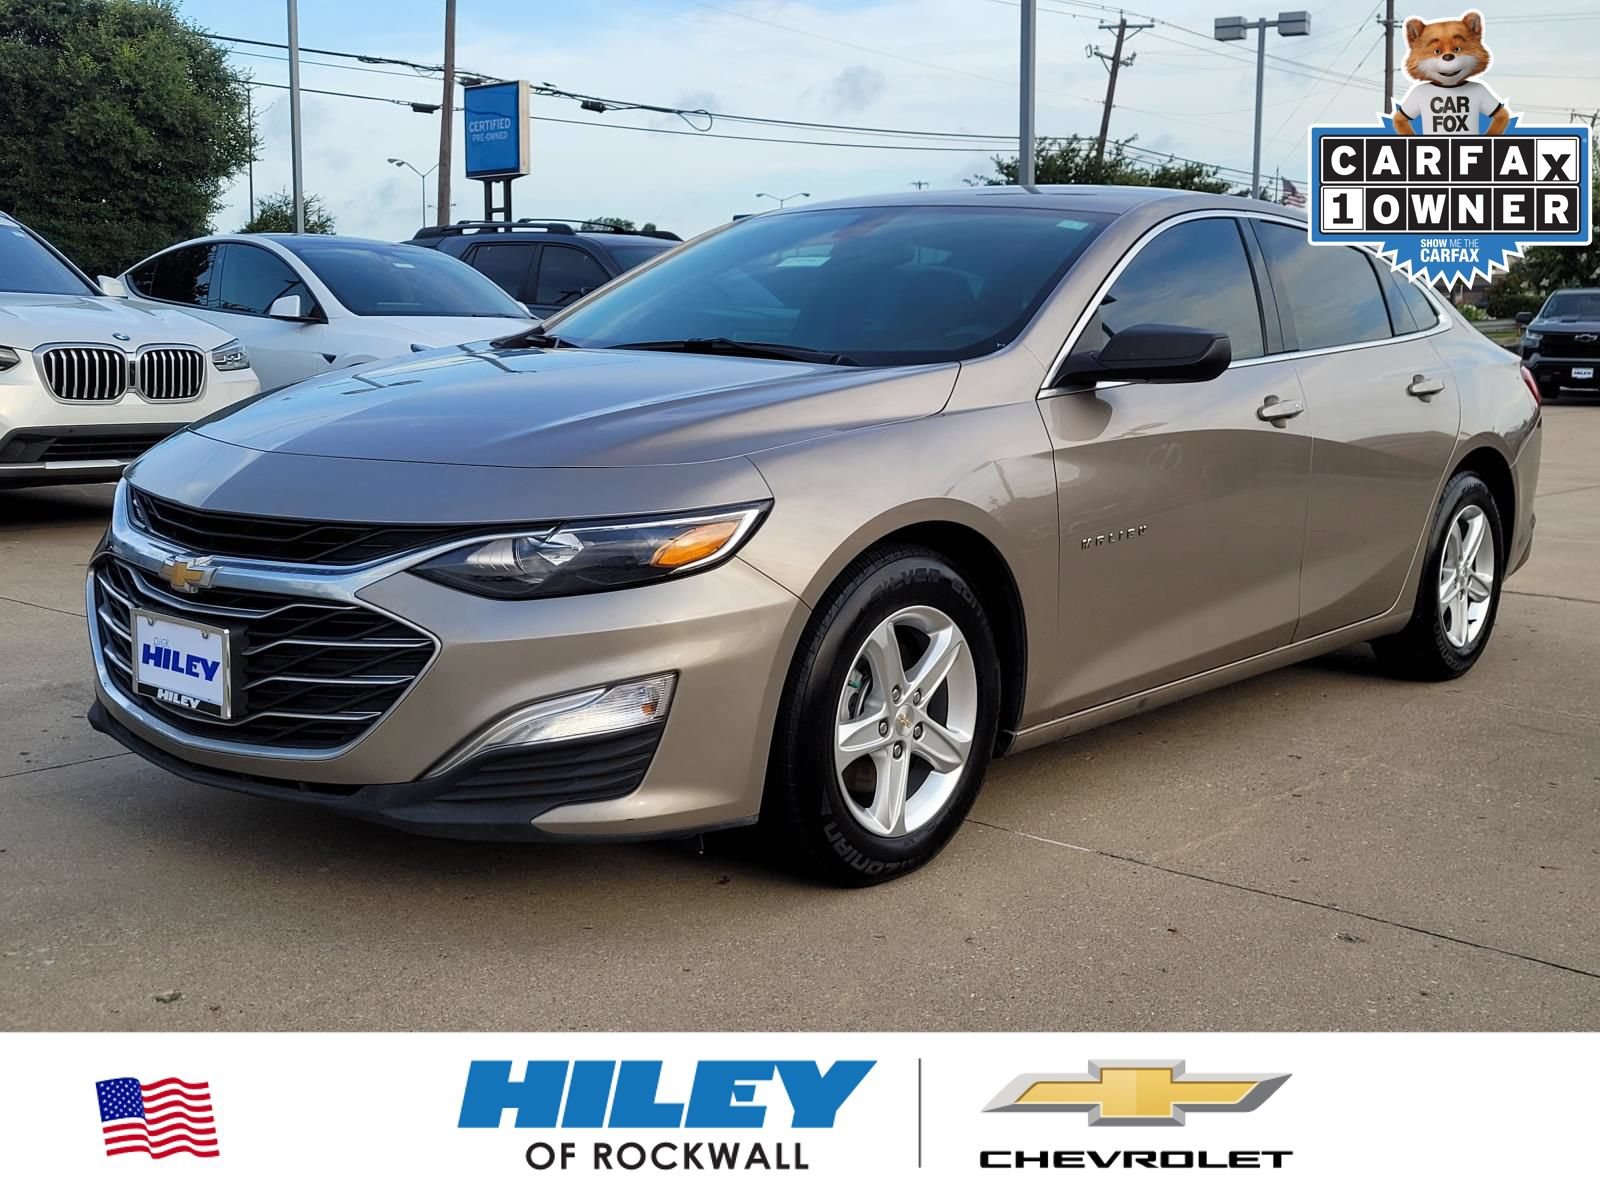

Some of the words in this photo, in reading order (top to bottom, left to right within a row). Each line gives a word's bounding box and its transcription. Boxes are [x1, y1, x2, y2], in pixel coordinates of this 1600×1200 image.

[469, 117, 511, 133] CERTIFIED
[142, 643, 221, 682] HILEY
[157, 688, 201, 709] HILEY
